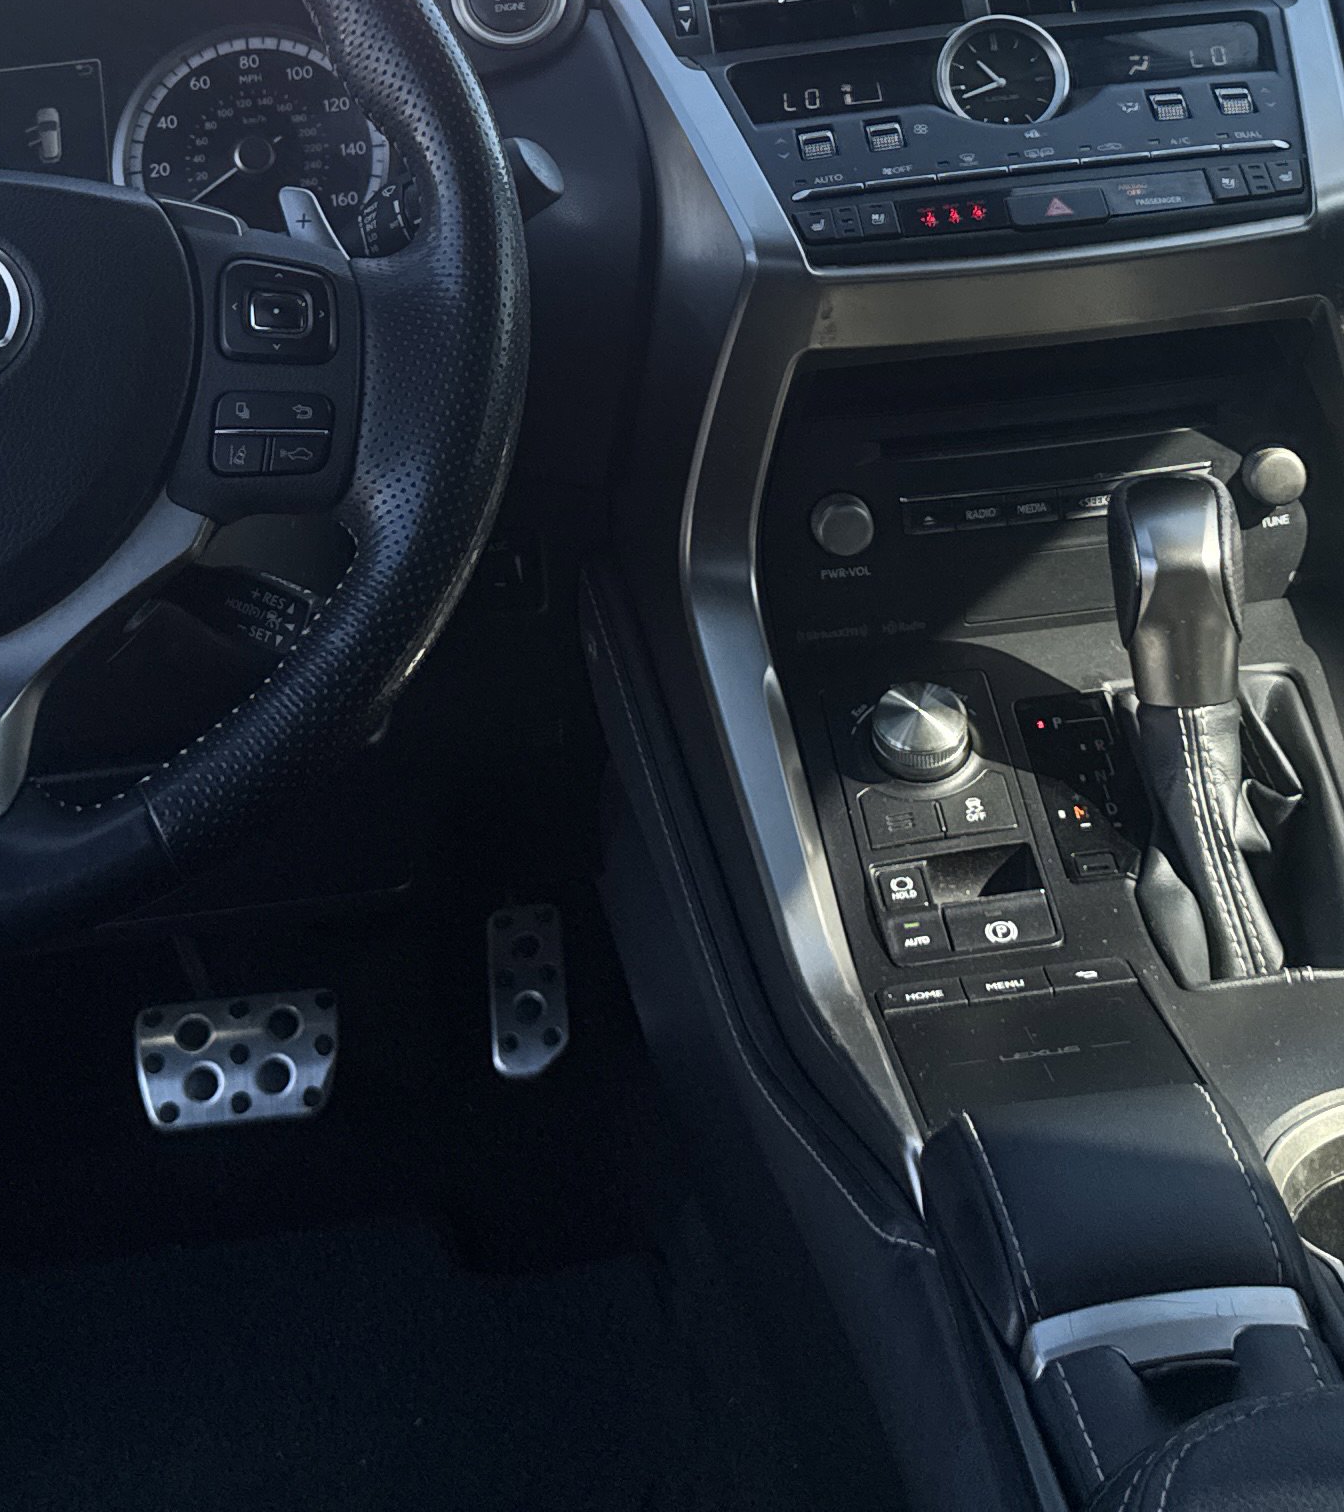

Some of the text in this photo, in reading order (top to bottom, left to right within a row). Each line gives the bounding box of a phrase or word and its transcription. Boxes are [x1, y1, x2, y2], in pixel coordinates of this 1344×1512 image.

[494, 2, 526, 13] ENGINE
[239, 55, 259, 70] 80
[1189, 46, 1227, 68] LO
[238, 73, 262, 85] MPH
[286, 65, 313, 81] 100
[189, 76, 211, 91] 60
[323, 96, 350, 113] 120
[783, 89, 820, 111] LO
[157, 115, 178, 129] 40
[1234, 130, 1262, 139] DUAL
[340, 141, 367, 156] 140
[150, 163, 170, 178] 20
[814, 174, 844, 185] AUTO
[330, 191, 359, 207] 160
[965, 507, 997, 520] RADIO
[1017, 502, 1047, 514] MEDIA
[262, 592, 286, 609] RES
[248, 625, 272, 642] SET
[1052, 717, 1062, 729] P
[1094, 739, 1106, 751] R
[1094, 769, 1107, 782] N
[966, 811, 987, 822] OFF
[1107, 802, 1118, 816] D
[891, 889, 918, 901] HOLD
[904, 935, 931, 948] AUTO
[905, 979, 1025, 1002] HOME MENU
